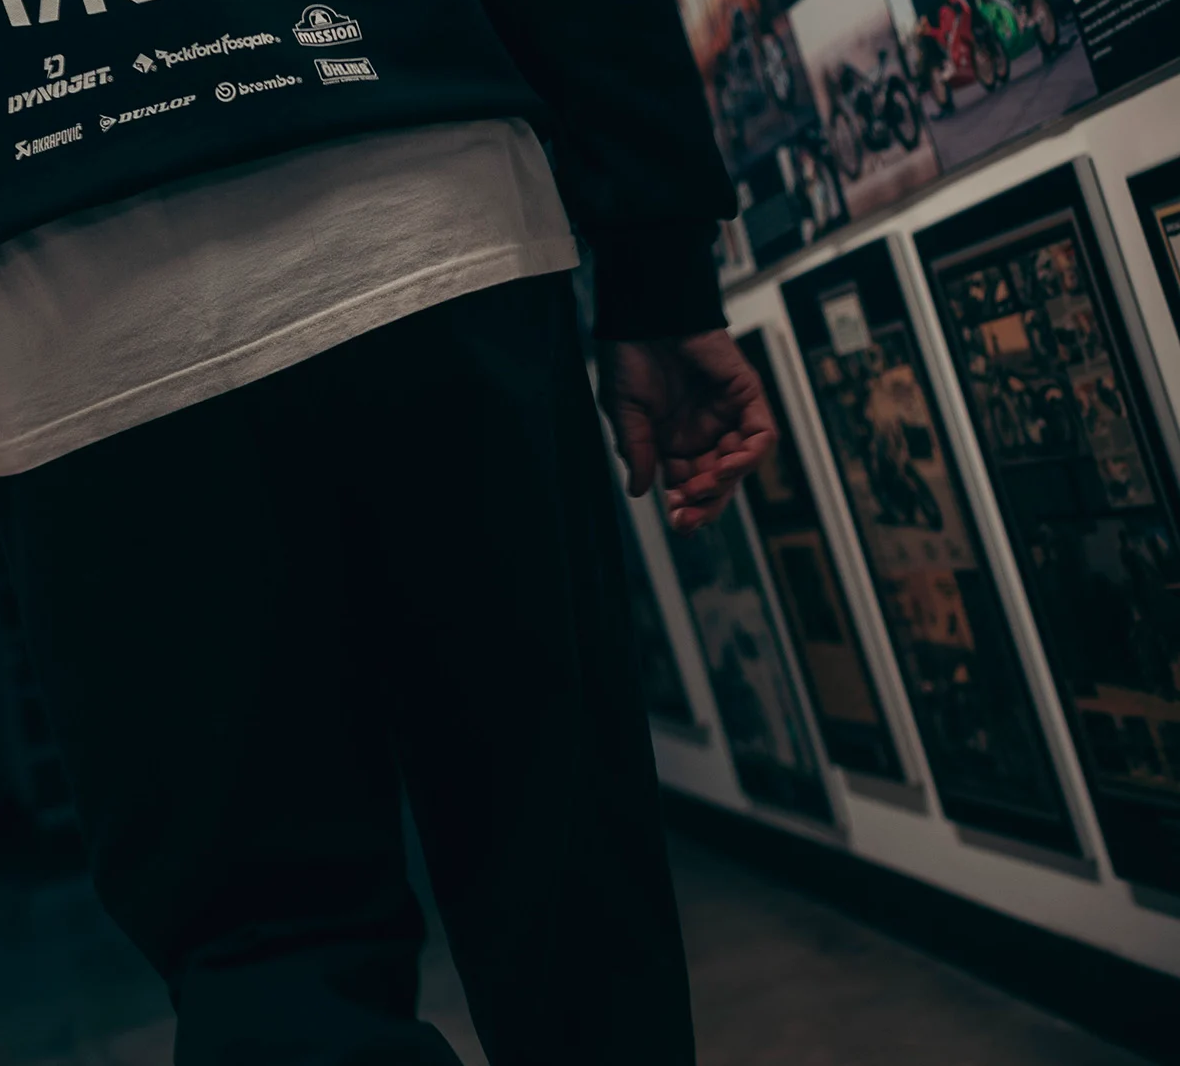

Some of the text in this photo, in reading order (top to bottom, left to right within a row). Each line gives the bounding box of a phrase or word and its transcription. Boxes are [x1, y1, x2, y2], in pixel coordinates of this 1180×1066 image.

[8, 66, 112, 114] DYNOJET
[238, 74, 297, 96] brembo
[118, 94, 197, 124] DUNLOP
